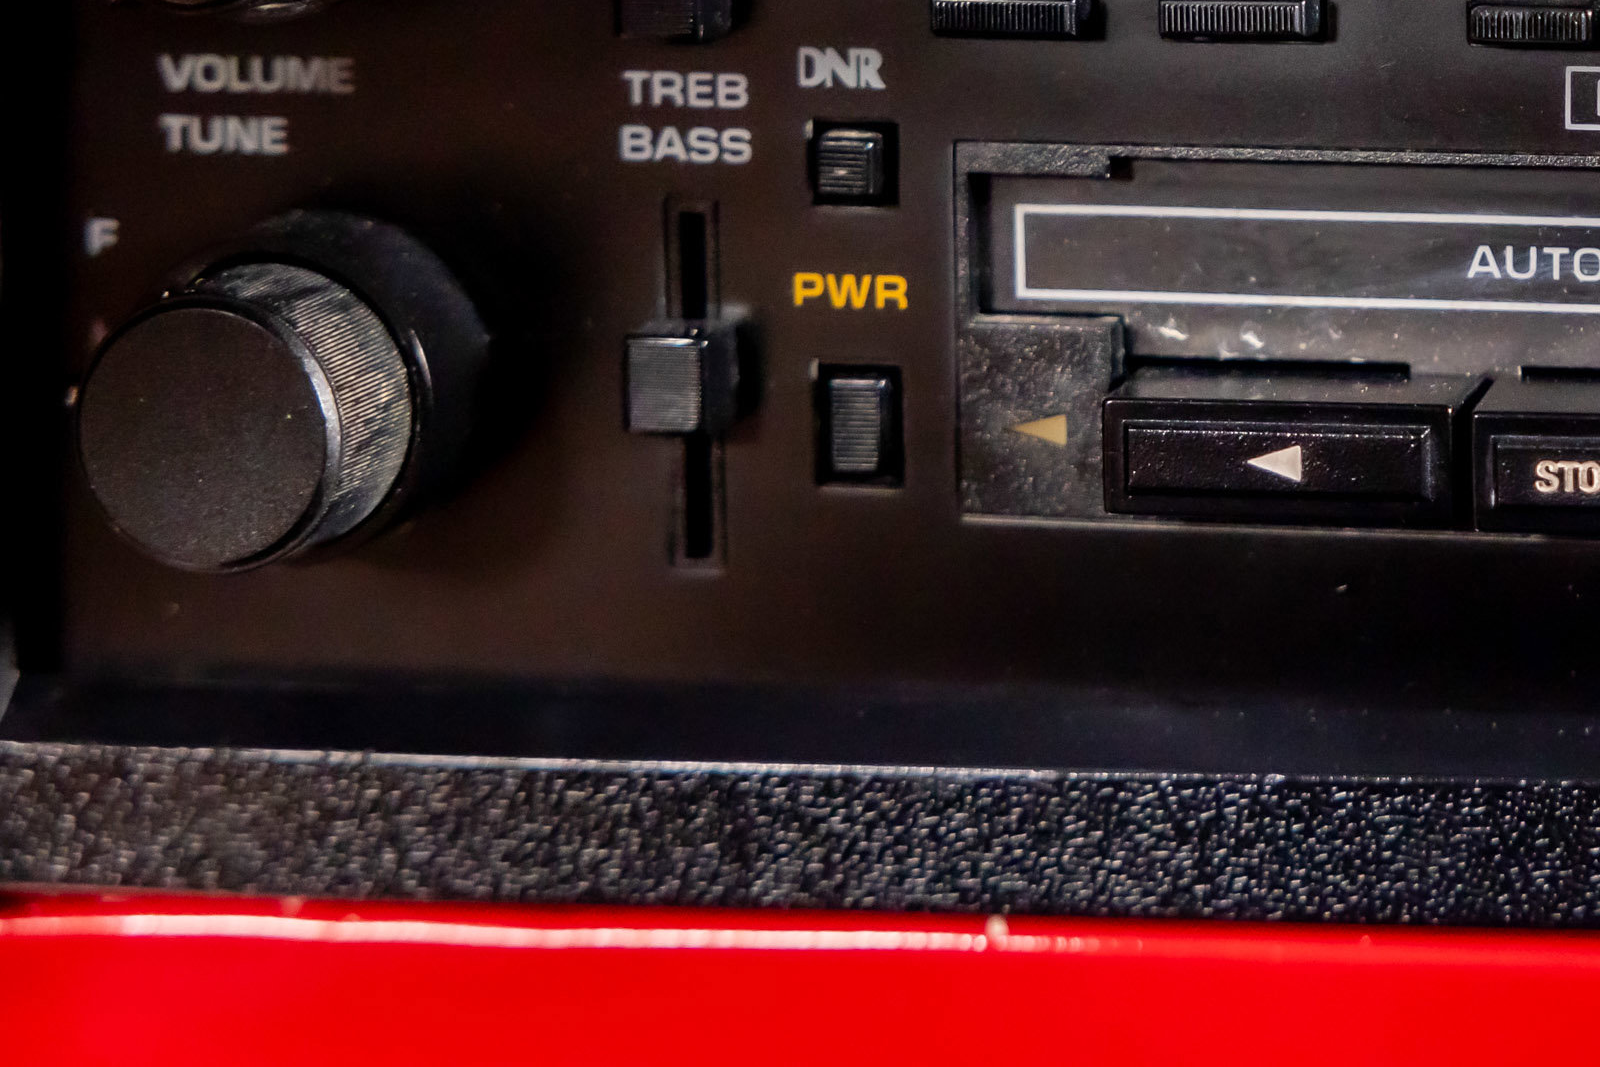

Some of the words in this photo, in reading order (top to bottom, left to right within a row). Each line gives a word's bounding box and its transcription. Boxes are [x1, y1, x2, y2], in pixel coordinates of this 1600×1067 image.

[160, 53, 355, 94] VOLUME
[798, 46, 886, 90] DNR
[623, 70, 749, 109] TREB
[160, 114, 290, 155] TUNE
[620, 125, 753, 164] BASS
[85, 217, 119, 256] F
[793, 272, 908, 310] PWR
